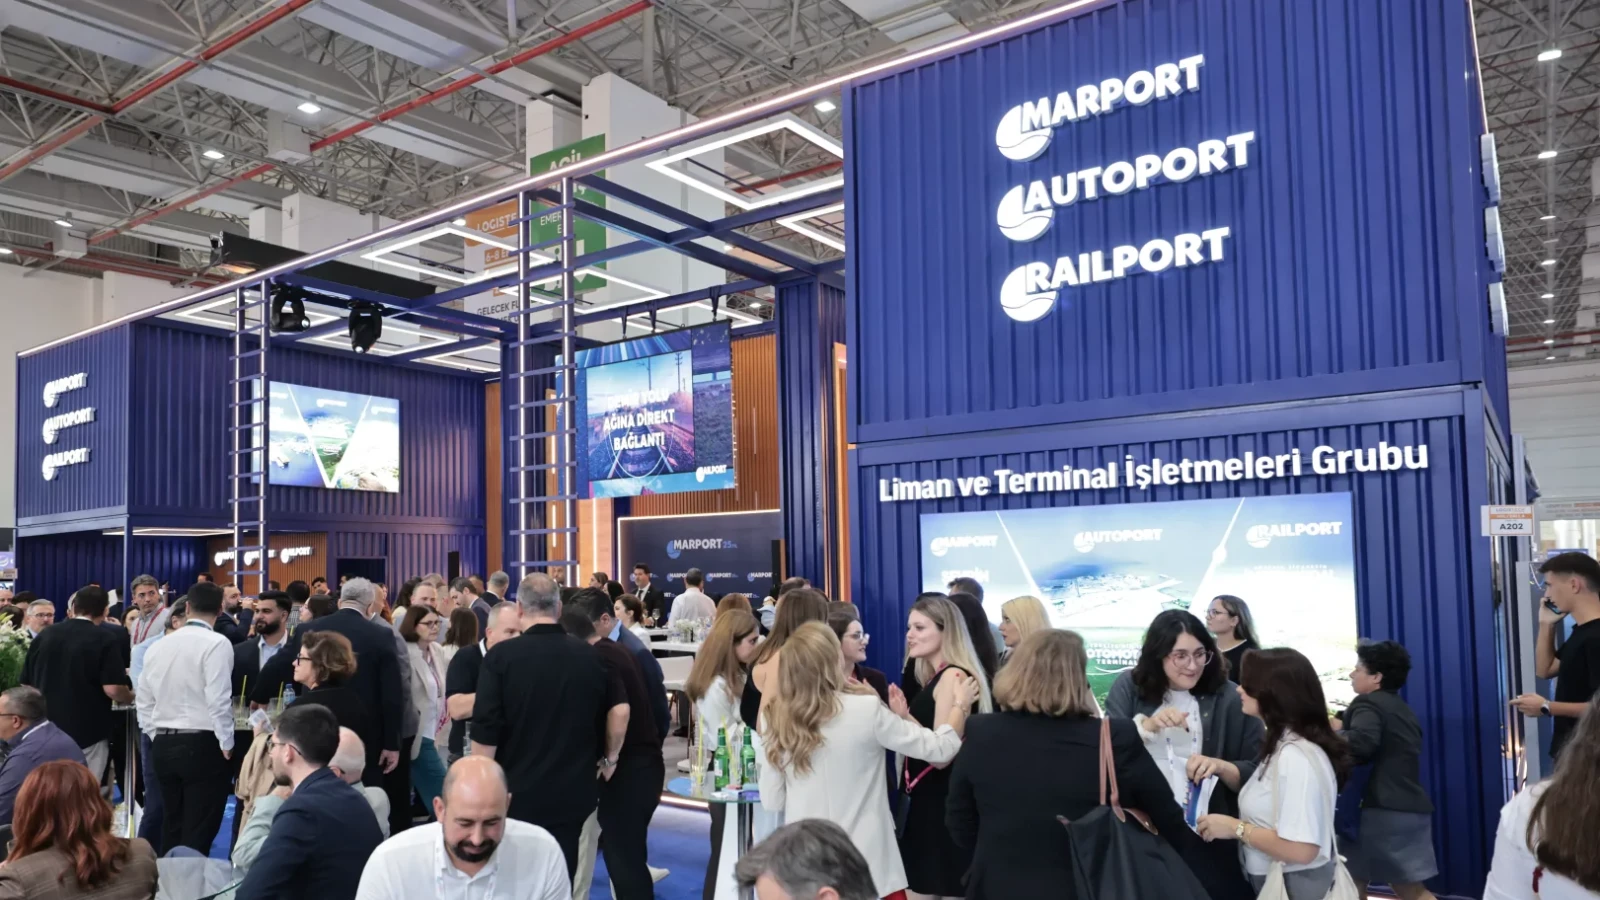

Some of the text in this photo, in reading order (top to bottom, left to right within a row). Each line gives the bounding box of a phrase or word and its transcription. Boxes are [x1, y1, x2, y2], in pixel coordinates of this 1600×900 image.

[1019, 54, 1205, 134] MARPORT
[1023, 131, 1255, 215] AUTOPORT
[1025, 227, 1231, 295] RAILPORT
[477, 302, 511, 316] GELECEK
[603, 408, 675, 431] AĞINA DİREKT
[613, 432, 665, 451] BAĞLANTI
[879, 441, 1429, 502] Liman ve Terminal İşletmeleri Grubu
[1081, 528, 1163, 545] AUTOPORT
[1254, 521, 1342, 540] RAILPORT
[671, 538, 723, 551] MARPORT
[1085, 648, 1143, 659] OTOMOT
